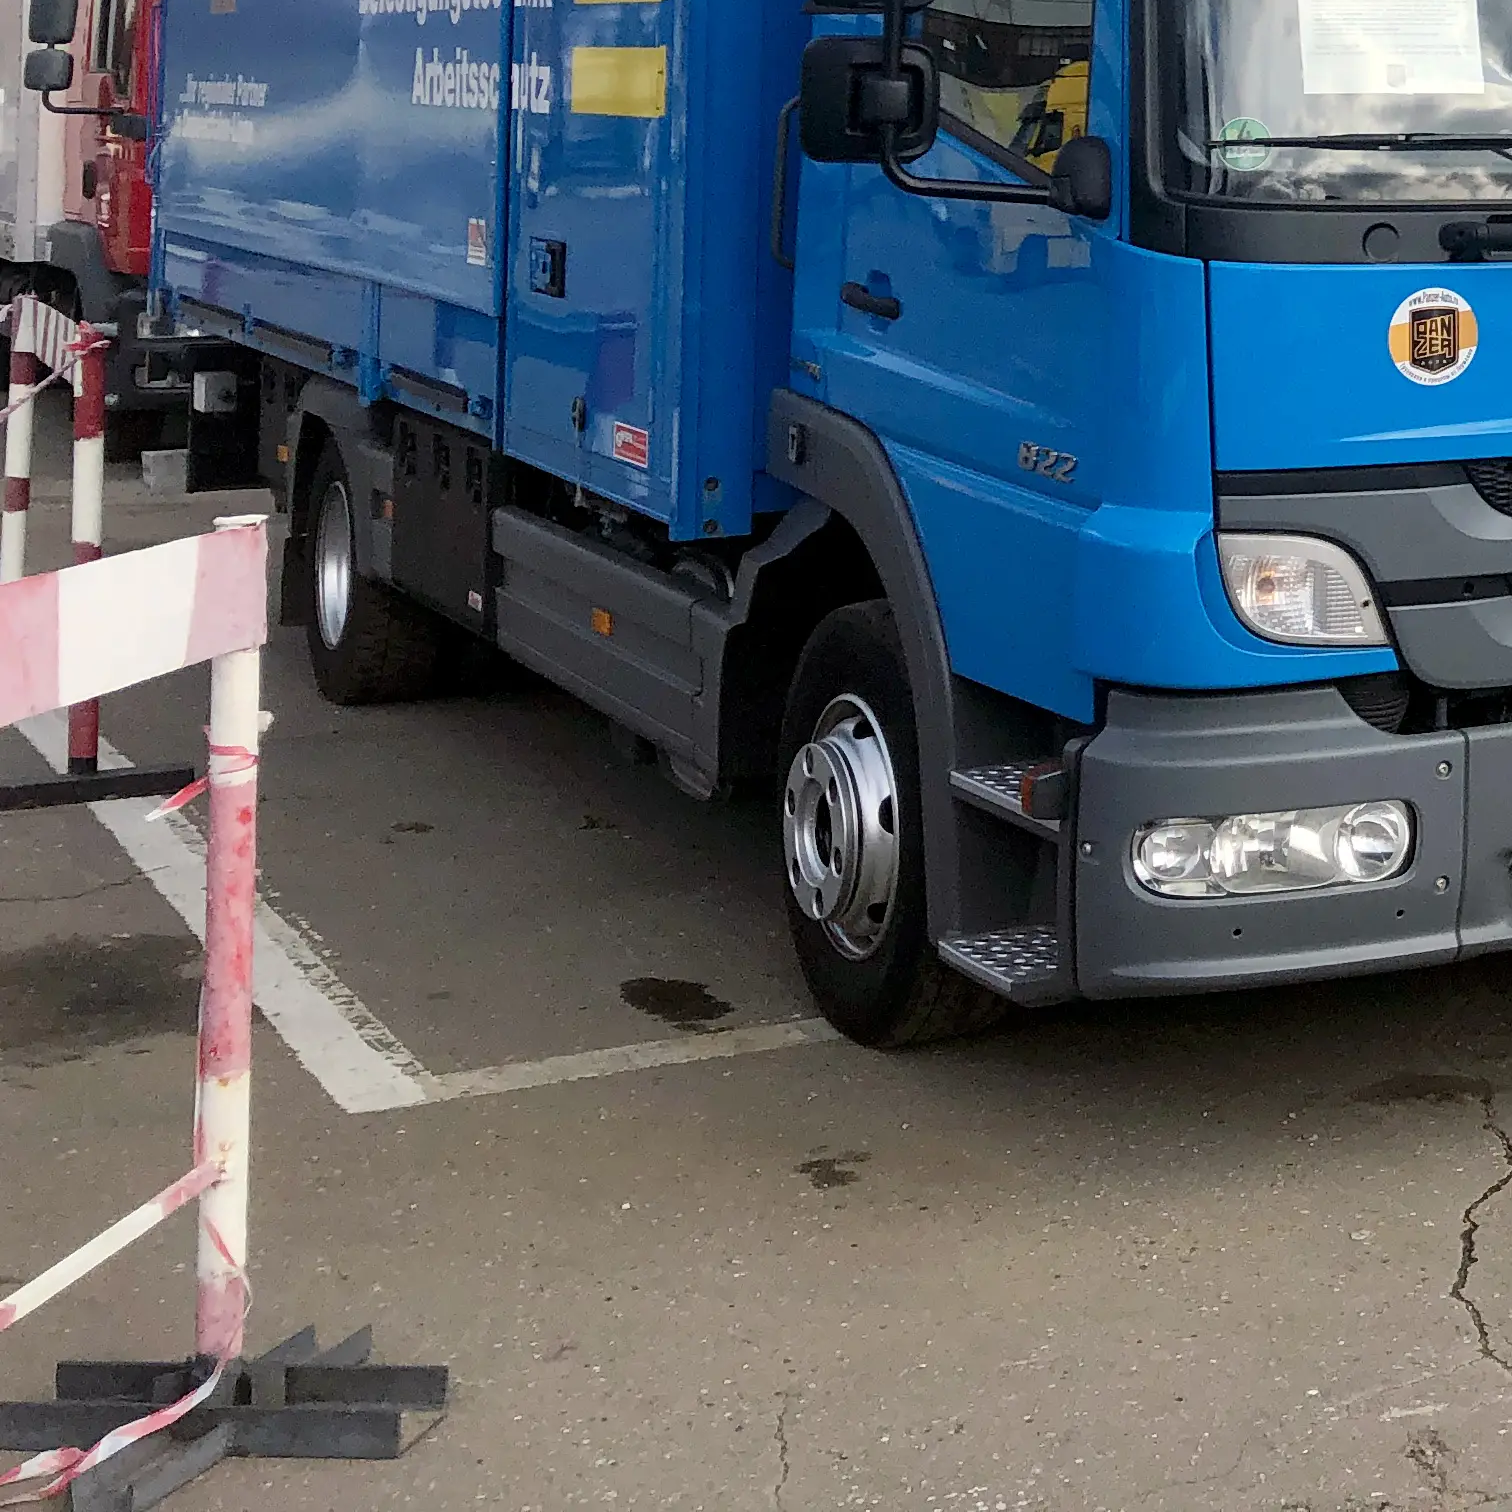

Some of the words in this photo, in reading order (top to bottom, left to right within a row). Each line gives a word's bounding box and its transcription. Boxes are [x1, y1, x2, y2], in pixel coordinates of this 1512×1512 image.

[1413, 314, 1454, 341] PAN
[1413, 336, 1454, 360] ZER
[1017, 441, 1078, 483] 822
